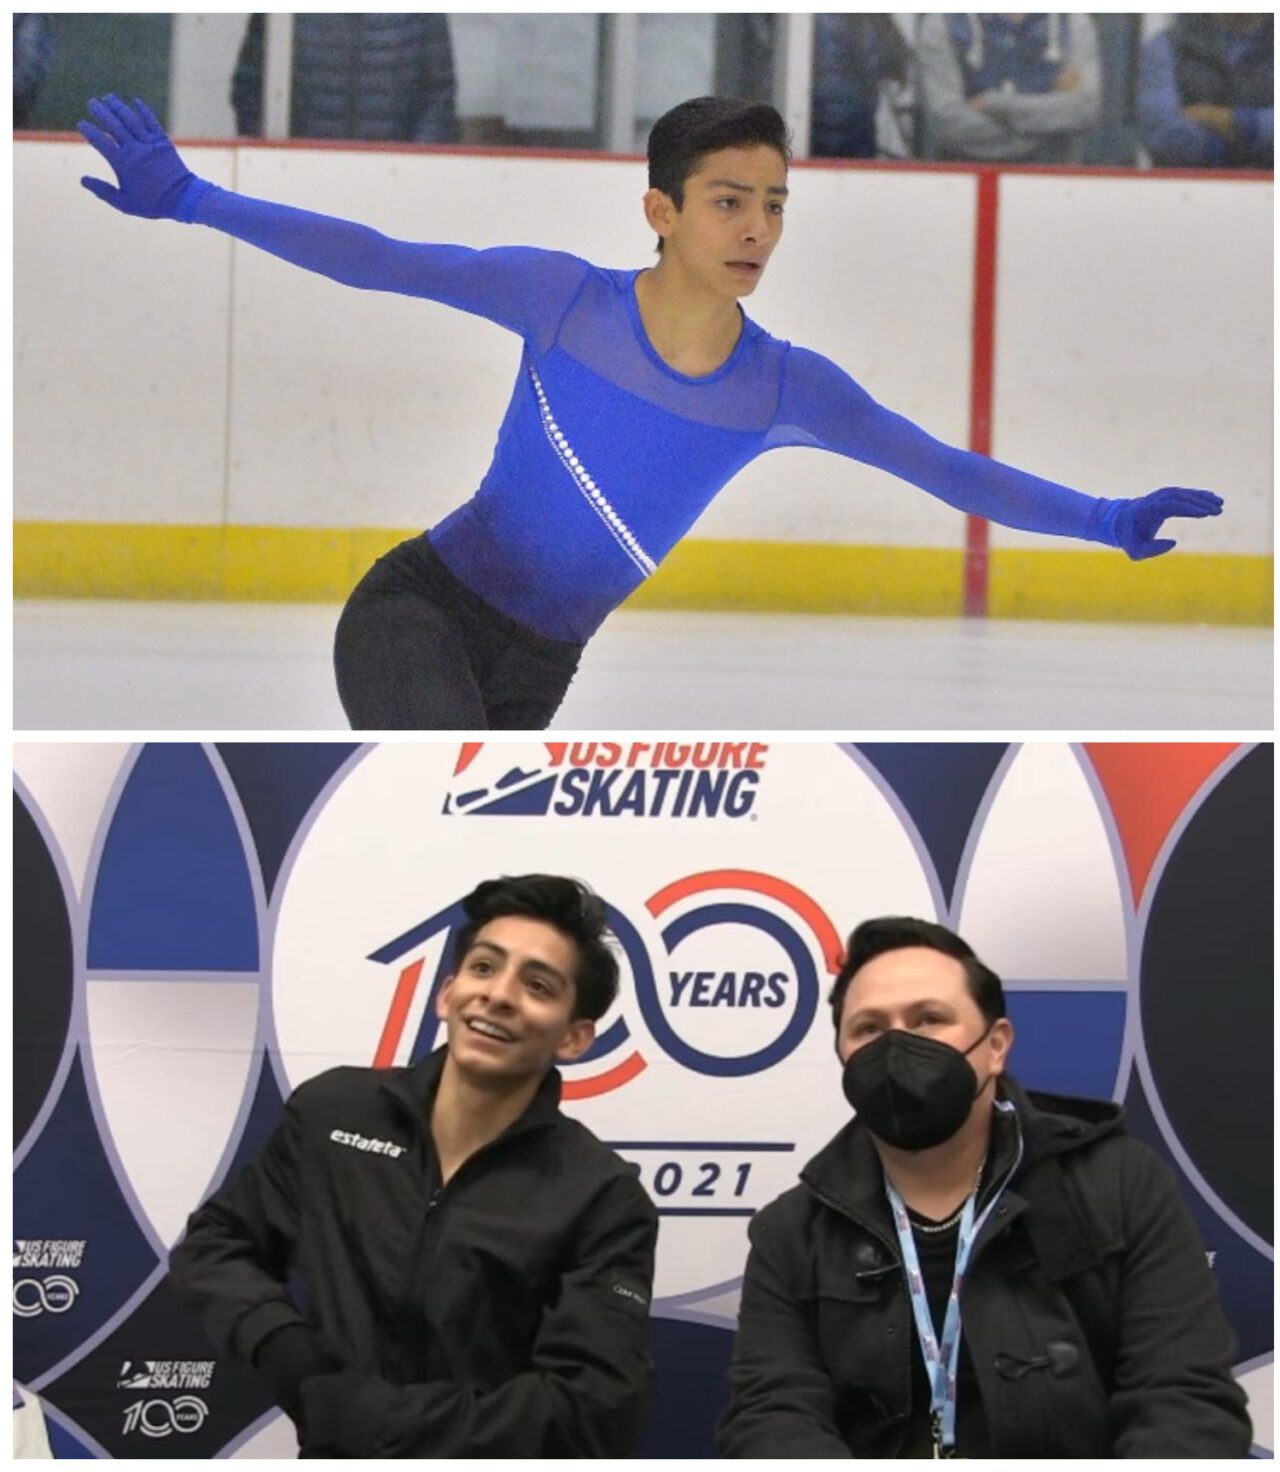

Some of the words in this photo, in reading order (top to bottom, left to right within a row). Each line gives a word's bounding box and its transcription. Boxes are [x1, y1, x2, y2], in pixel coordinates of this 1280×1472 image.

[554, 768, 760, 818] SKATING
[669, 971, 790, 1008] YEARS
[330, 1129, 402, 1158] estafeta
[653, 1162, 752, 1197] 021
[21, 1252, 81, 1267] SKATING
[150, 1374, 211, 1388] SKATING
[155, 1361, 173, 1374] US
[173, 1361, 216, 1376] FIGURE
